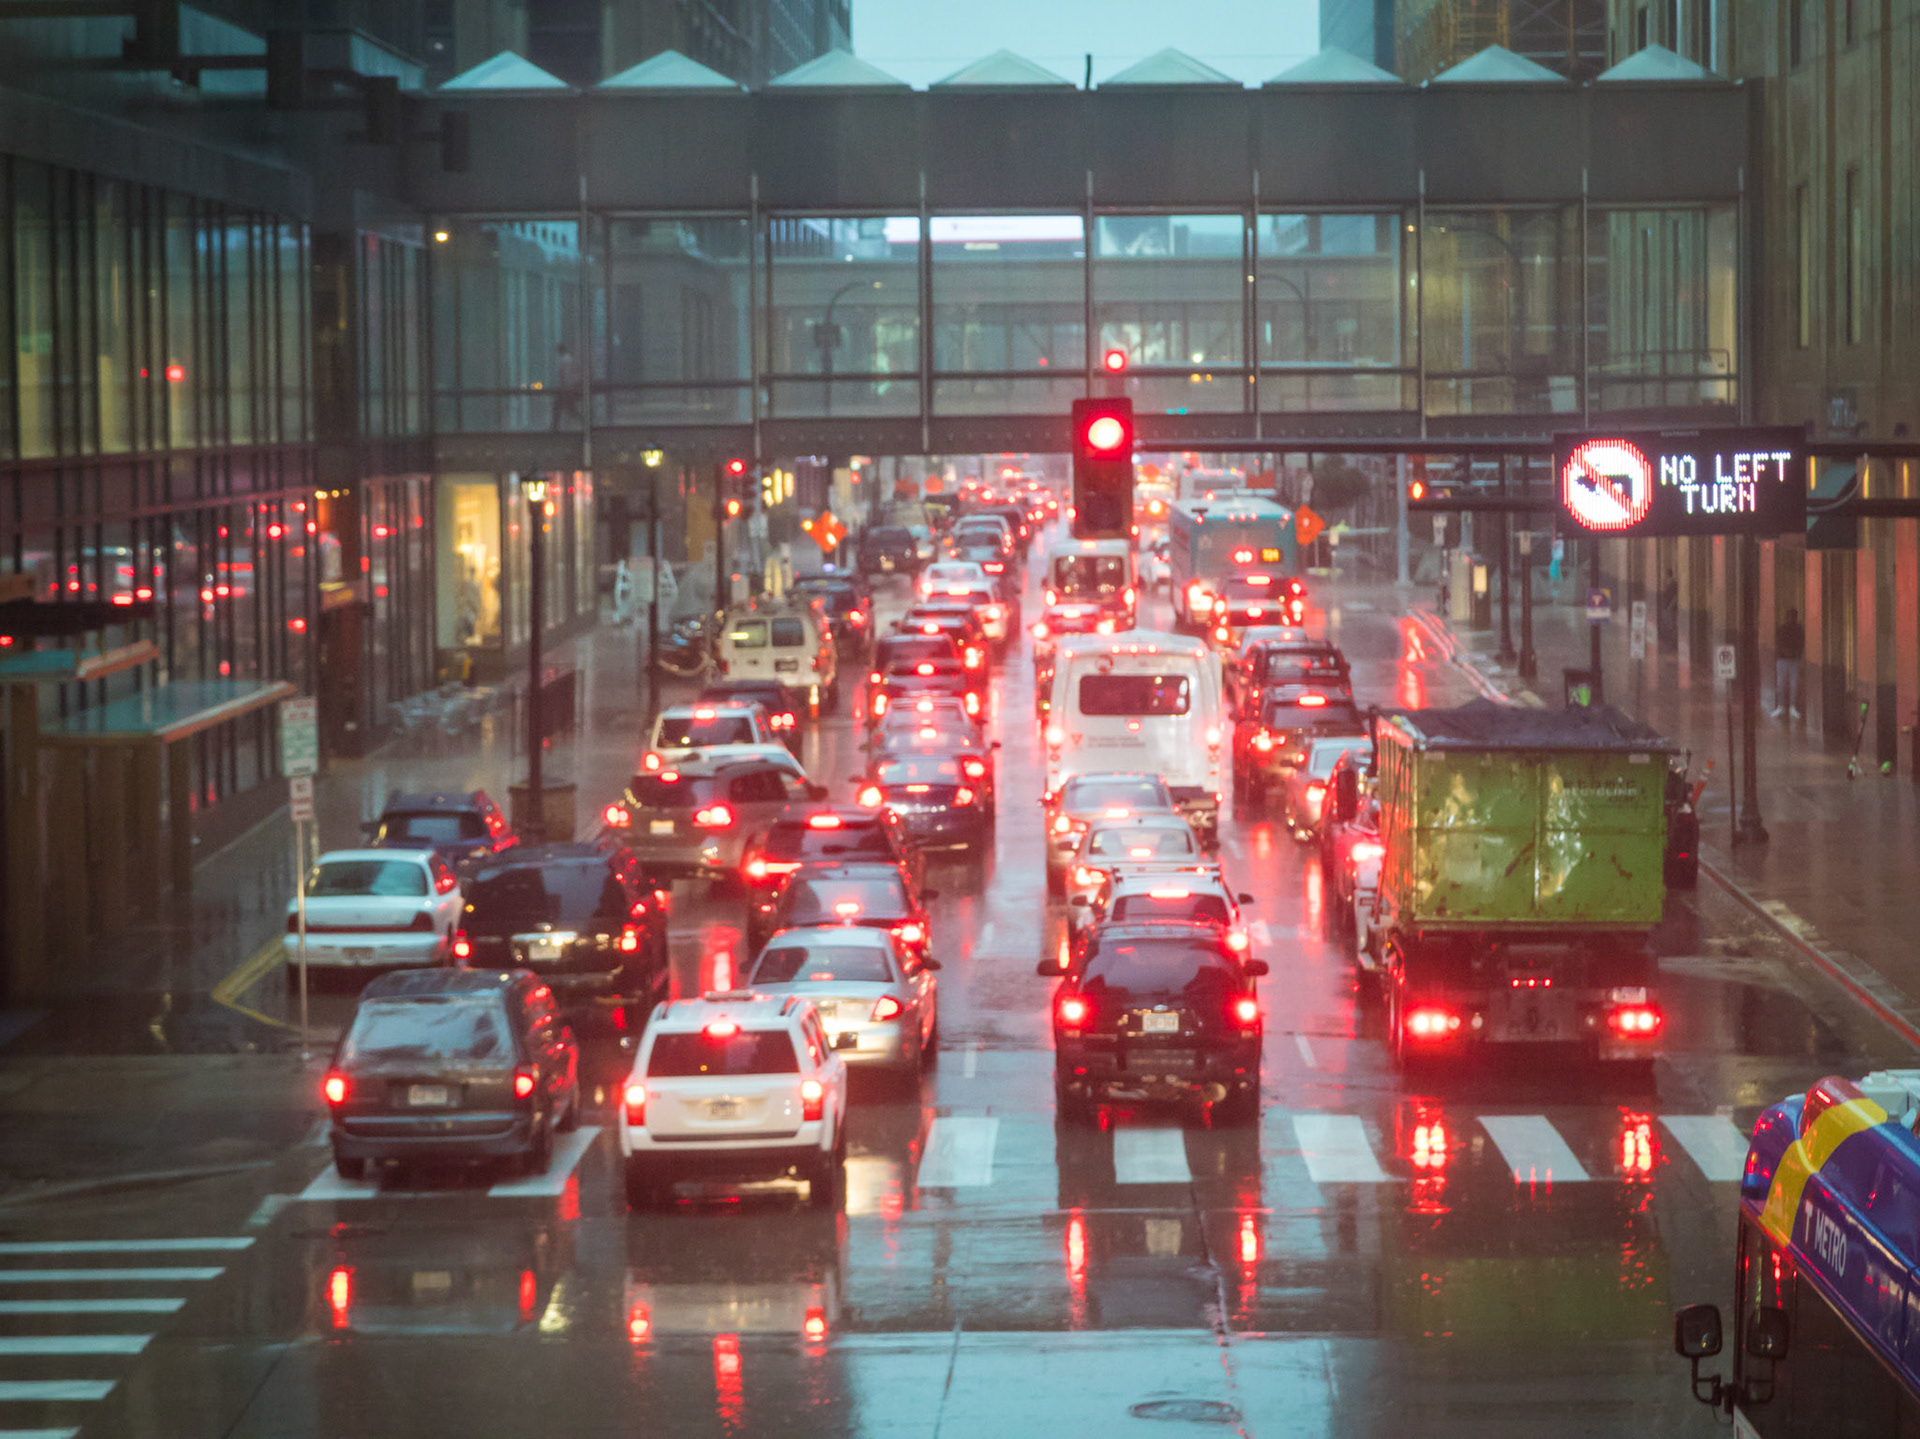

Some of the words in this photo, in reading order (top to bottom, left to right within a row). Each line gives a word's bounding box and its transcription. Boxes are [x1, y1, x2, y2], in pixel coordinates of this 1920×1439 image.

[1660, 454, 1696, 485] NO
[1715, 451, 1791, 483] LEFT
[1679, 483, 1755, 514] TURN
[1804, 1199, 1814, 1244] T
[1814, 1207, 1847, 1278] METRO
